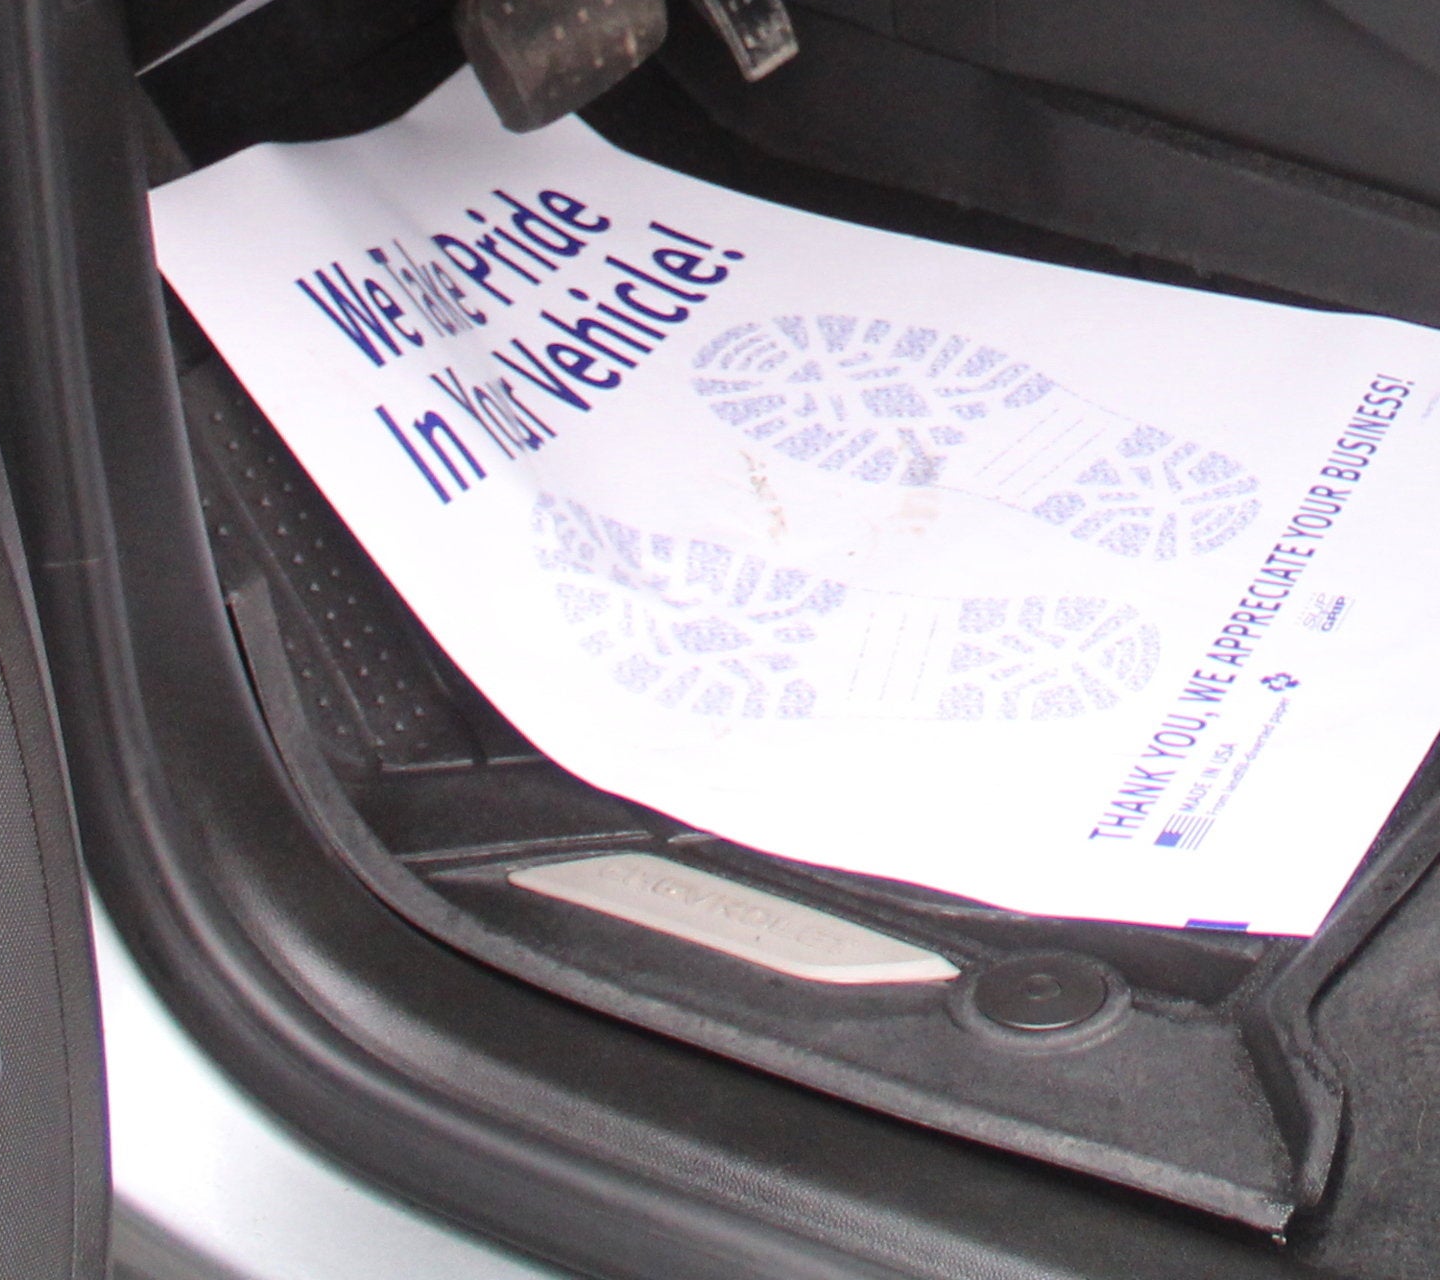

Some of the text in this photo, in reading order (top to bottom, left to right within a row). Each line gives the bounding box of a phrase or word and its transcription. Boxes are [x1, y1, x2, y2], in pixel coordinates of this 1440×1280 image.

[295, 261, 425, 367] We
[431, 189, 611, 307] Pride
[375, 404, 487, 505] In
[491, 221, 745, 412] Vehicle!
[1088, 372, 1415, 840] THANK YOU, WE APPRECIATE YOUR BUSINESS!
[1321, 595, 1346, 632] GRIP
[1179, 743, 1238, 813] MADE IN USA
